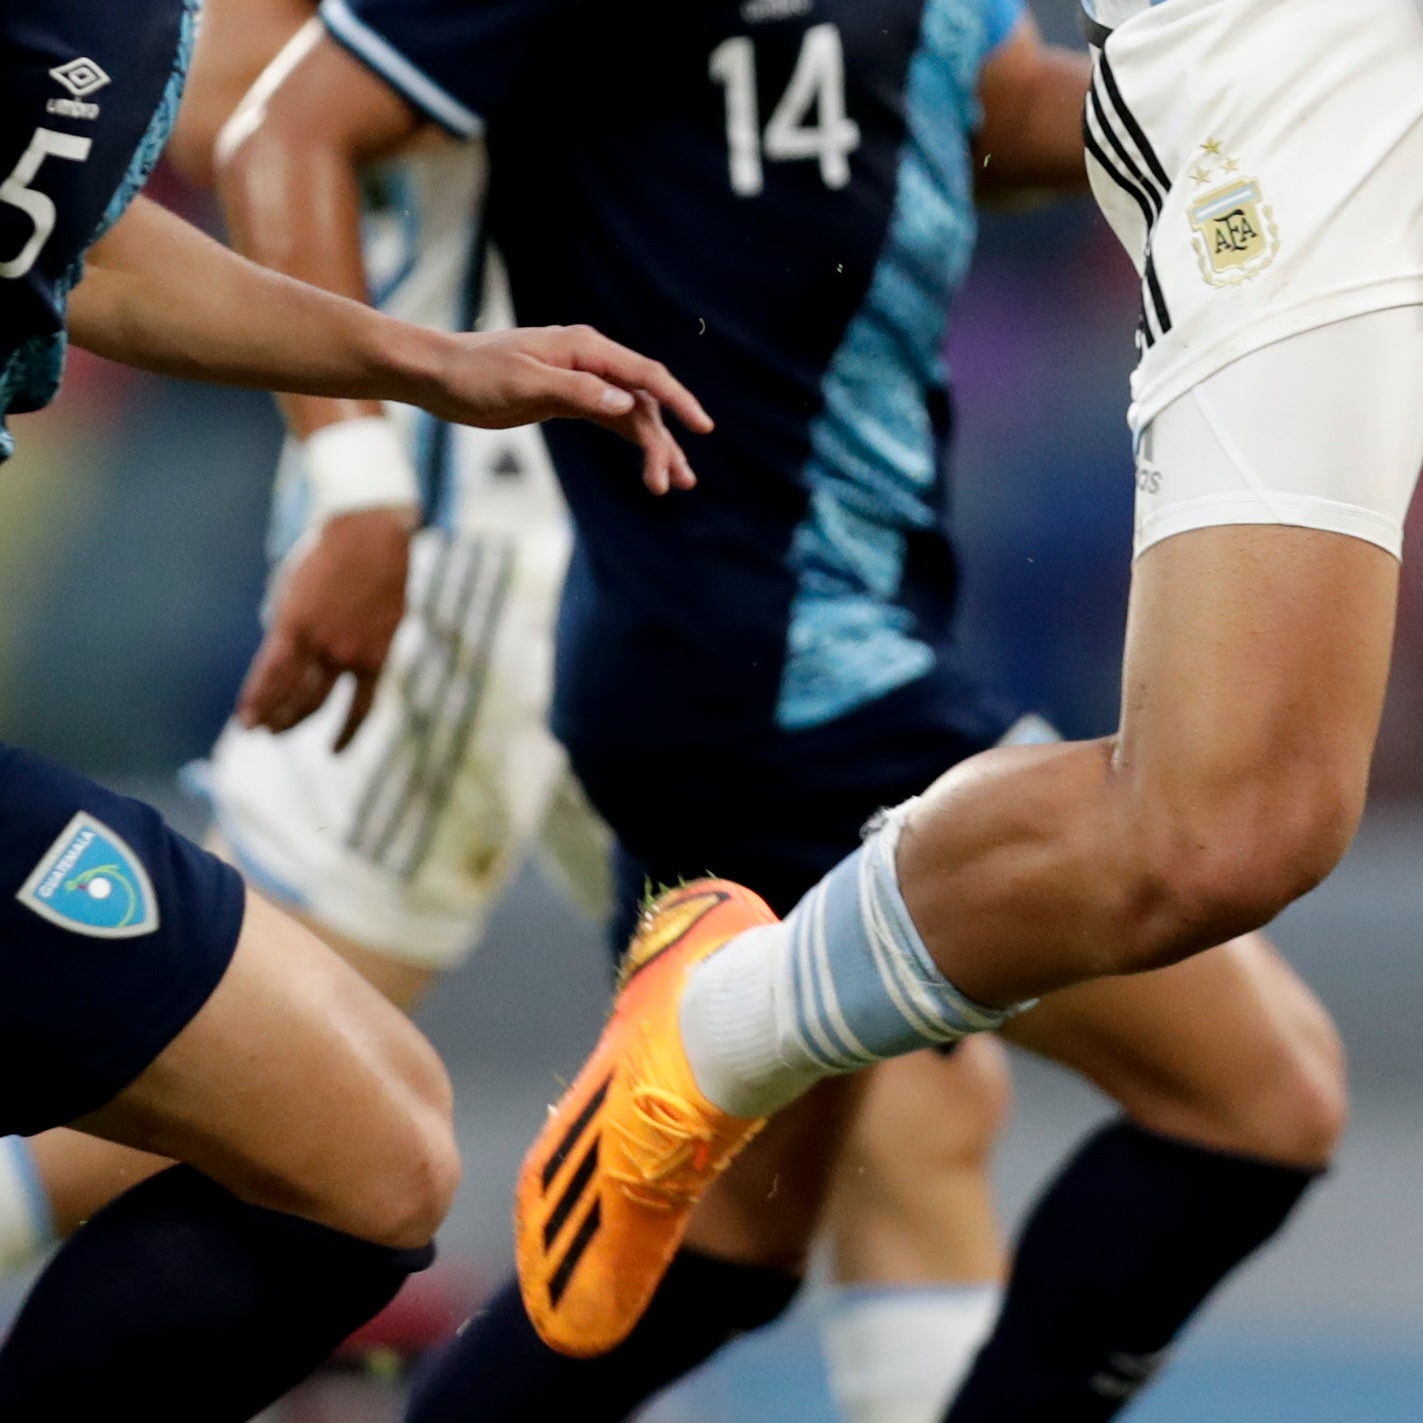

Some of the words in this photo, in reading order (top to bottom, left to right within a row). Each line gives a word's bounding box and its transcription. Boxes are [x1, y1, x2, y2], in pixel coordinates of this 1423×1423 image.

[708, 23, 861, 199] 14
[0, 126, 93, 279] 5
[1213, 209, 1257, 254] AFA
[39, 830, 96, 898] GUATEMALA
